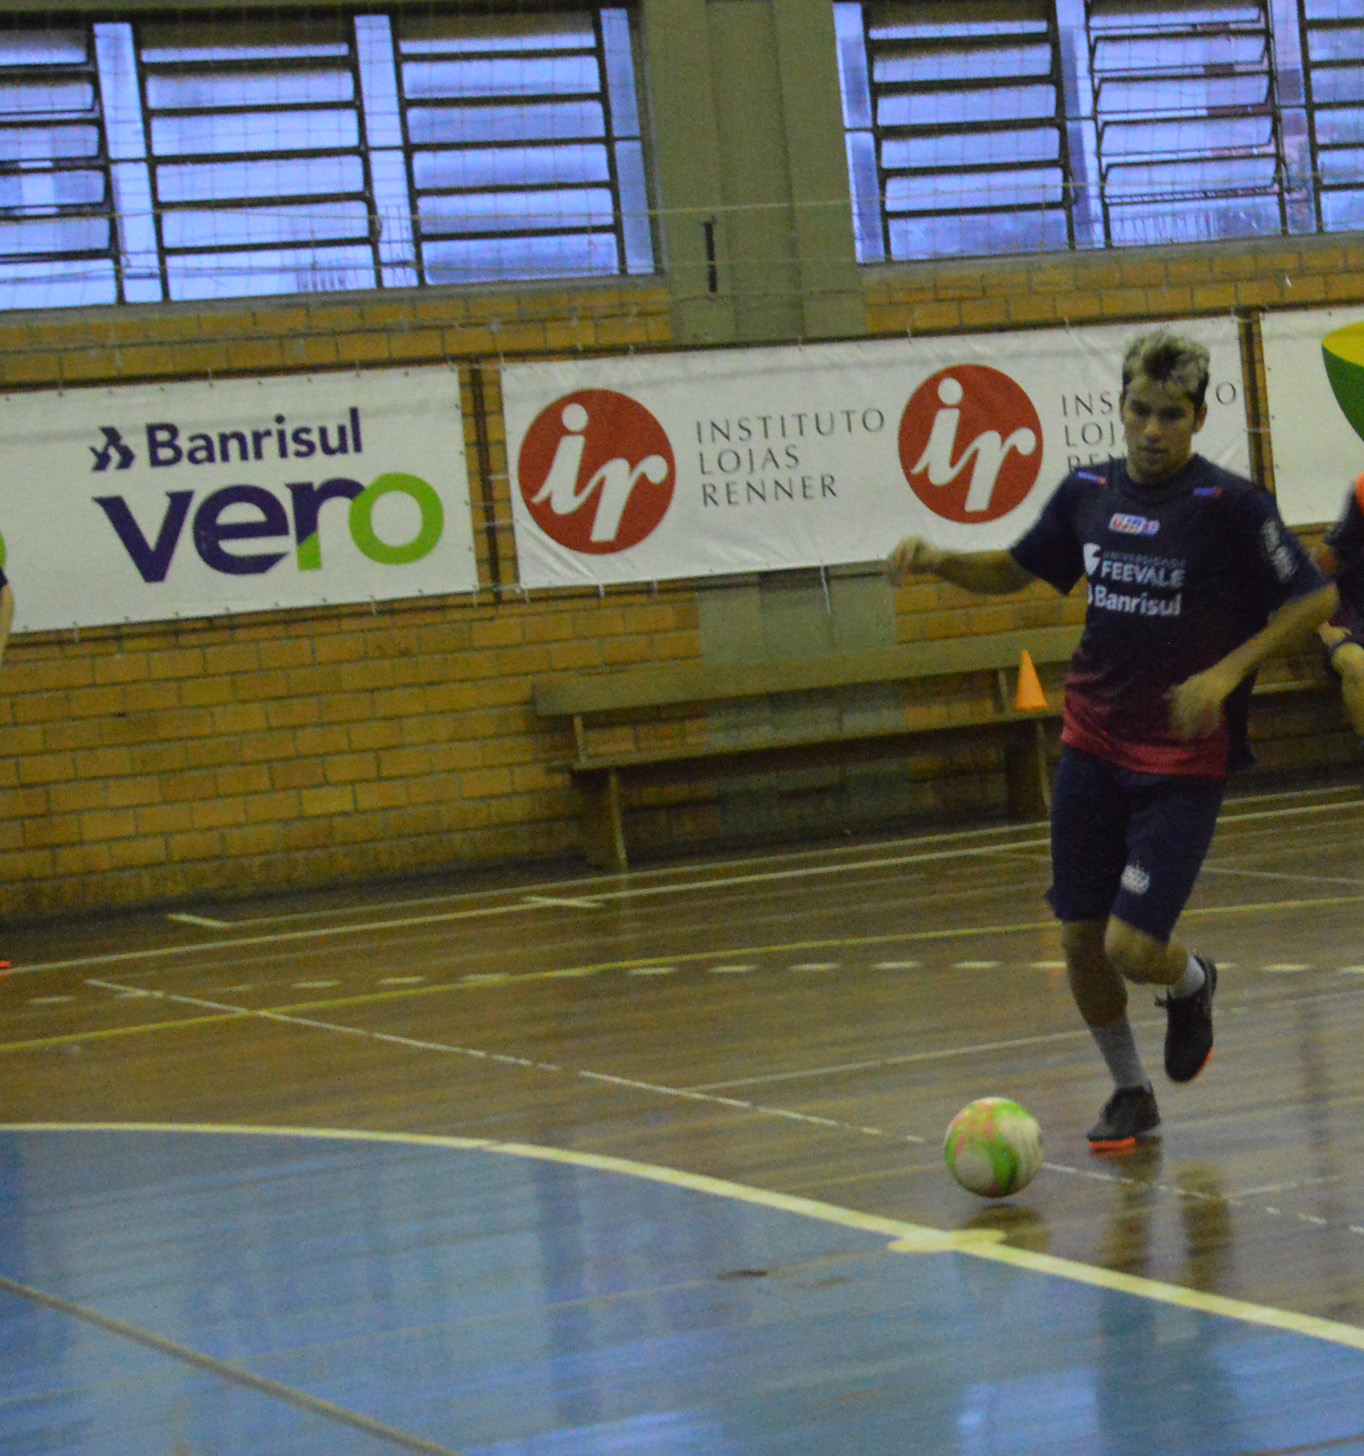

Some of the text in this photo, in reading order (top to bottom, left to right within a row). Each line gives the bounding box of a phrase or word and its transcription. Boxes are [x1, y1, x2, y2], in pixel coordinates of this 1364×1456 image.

[145, 406, 363, 468] Banrisul
[696, 407, 884, 443] INSTITUTO
[1065, 421, 1124, 448] LOJ
[699, 444, 799, 475] LOJAS
[702, 474, 838, 507] RENNER
[91, 472, 444, 583] vero
[1101, 560, 1185, 589] FEEVALE
[1094, 584, 1182, 616] Banrisul
